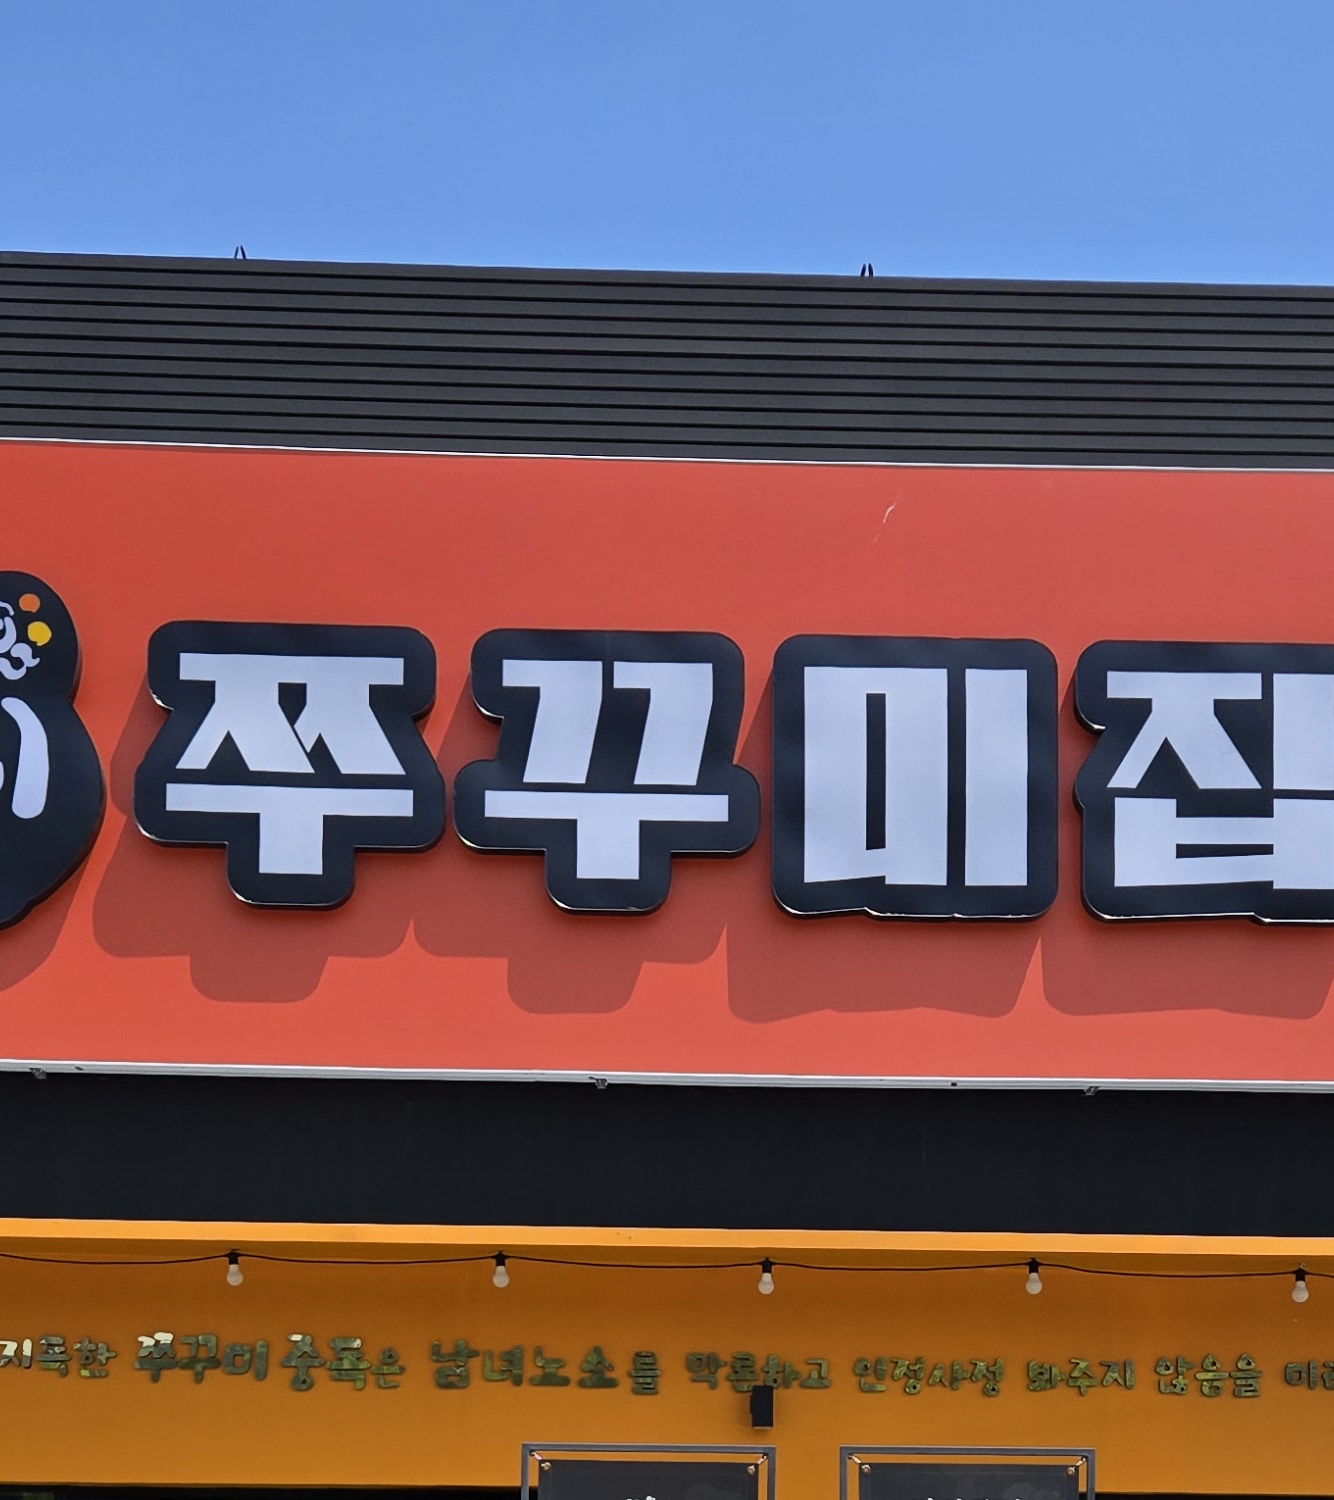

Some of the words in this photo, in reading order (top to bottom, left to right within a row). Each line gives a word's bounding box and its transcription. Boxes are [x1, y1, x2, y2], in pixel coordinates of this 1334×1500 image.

[134, 1332, 267, 1384] 쭈꾸미
[280, 1333, 405, 1391] 중독은
[431, 1338, 662, 1395] 남녀노소를
[685, 1351, 832, 1393] 막론하고
[853, 1356, 1005, 1397] 인정사정
[1025, 1356, 1136, 1396] 봐주지
[1154, 1353, 1263, 1399] 않음을
